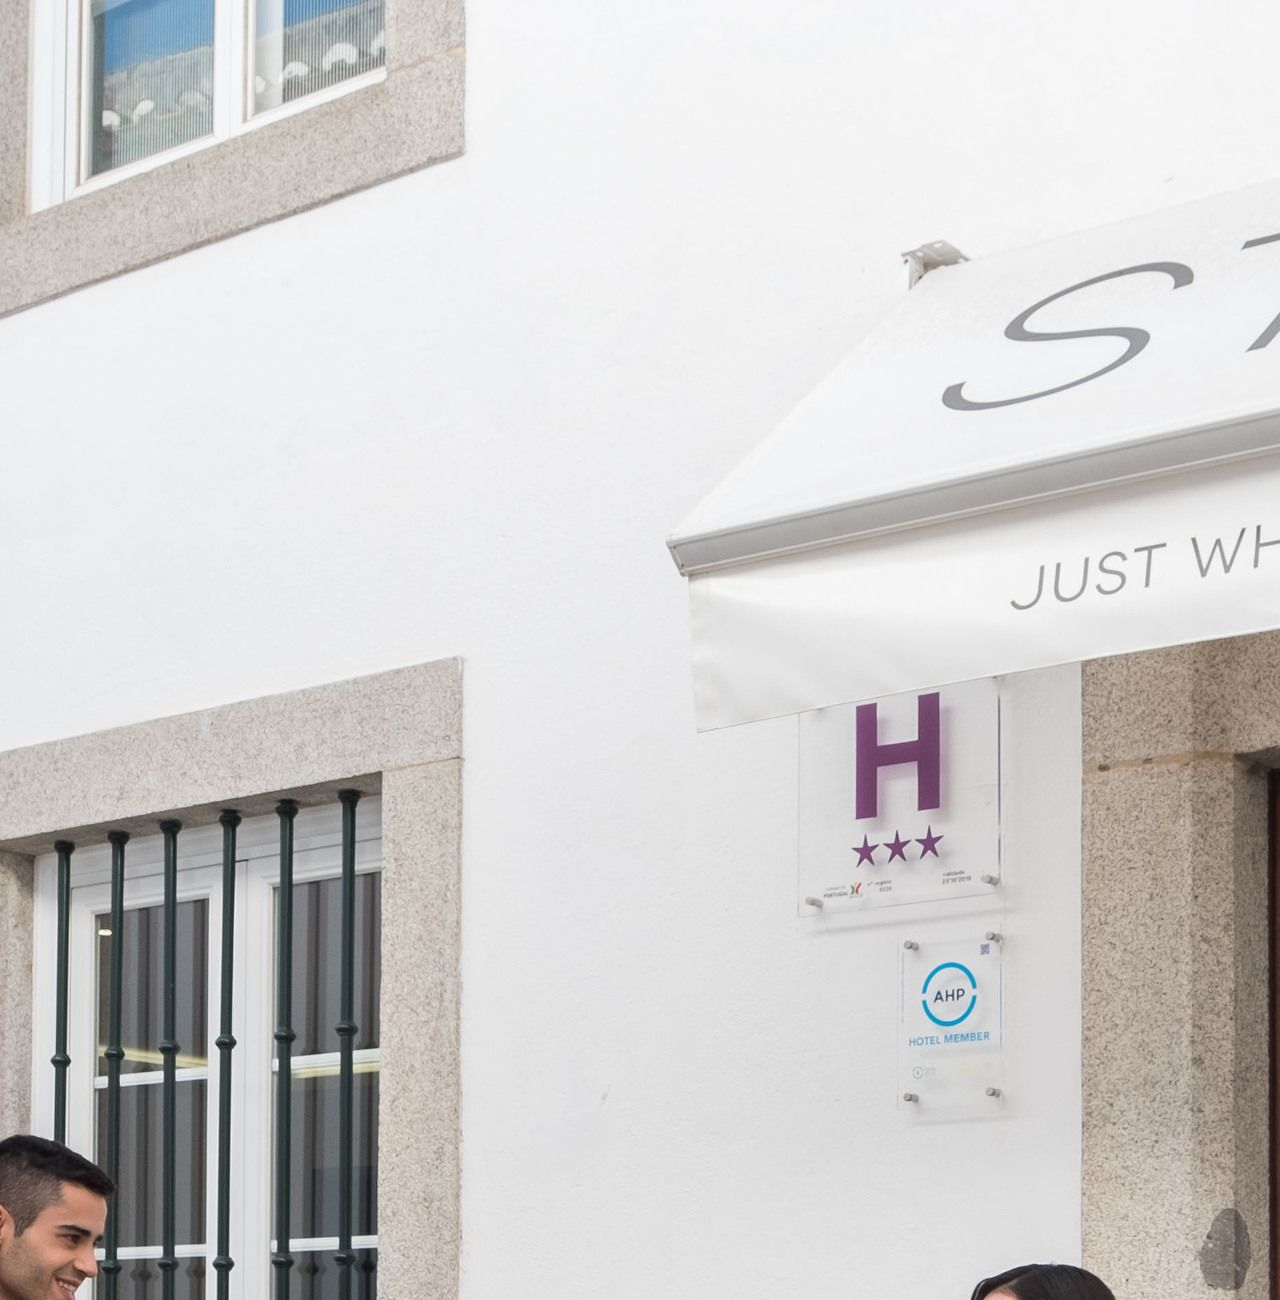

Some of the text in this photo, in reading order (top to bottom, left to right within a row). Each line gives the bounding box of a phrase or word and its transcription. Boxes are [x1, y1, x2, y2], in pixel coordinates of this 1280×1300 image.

[1011, 543, 1167, 610] JUST
[856, 692, 940, 820] H
[933, 988, 966, 1003] AHP
[908, 1031, 990, 1047] HOTEL MEMBER
